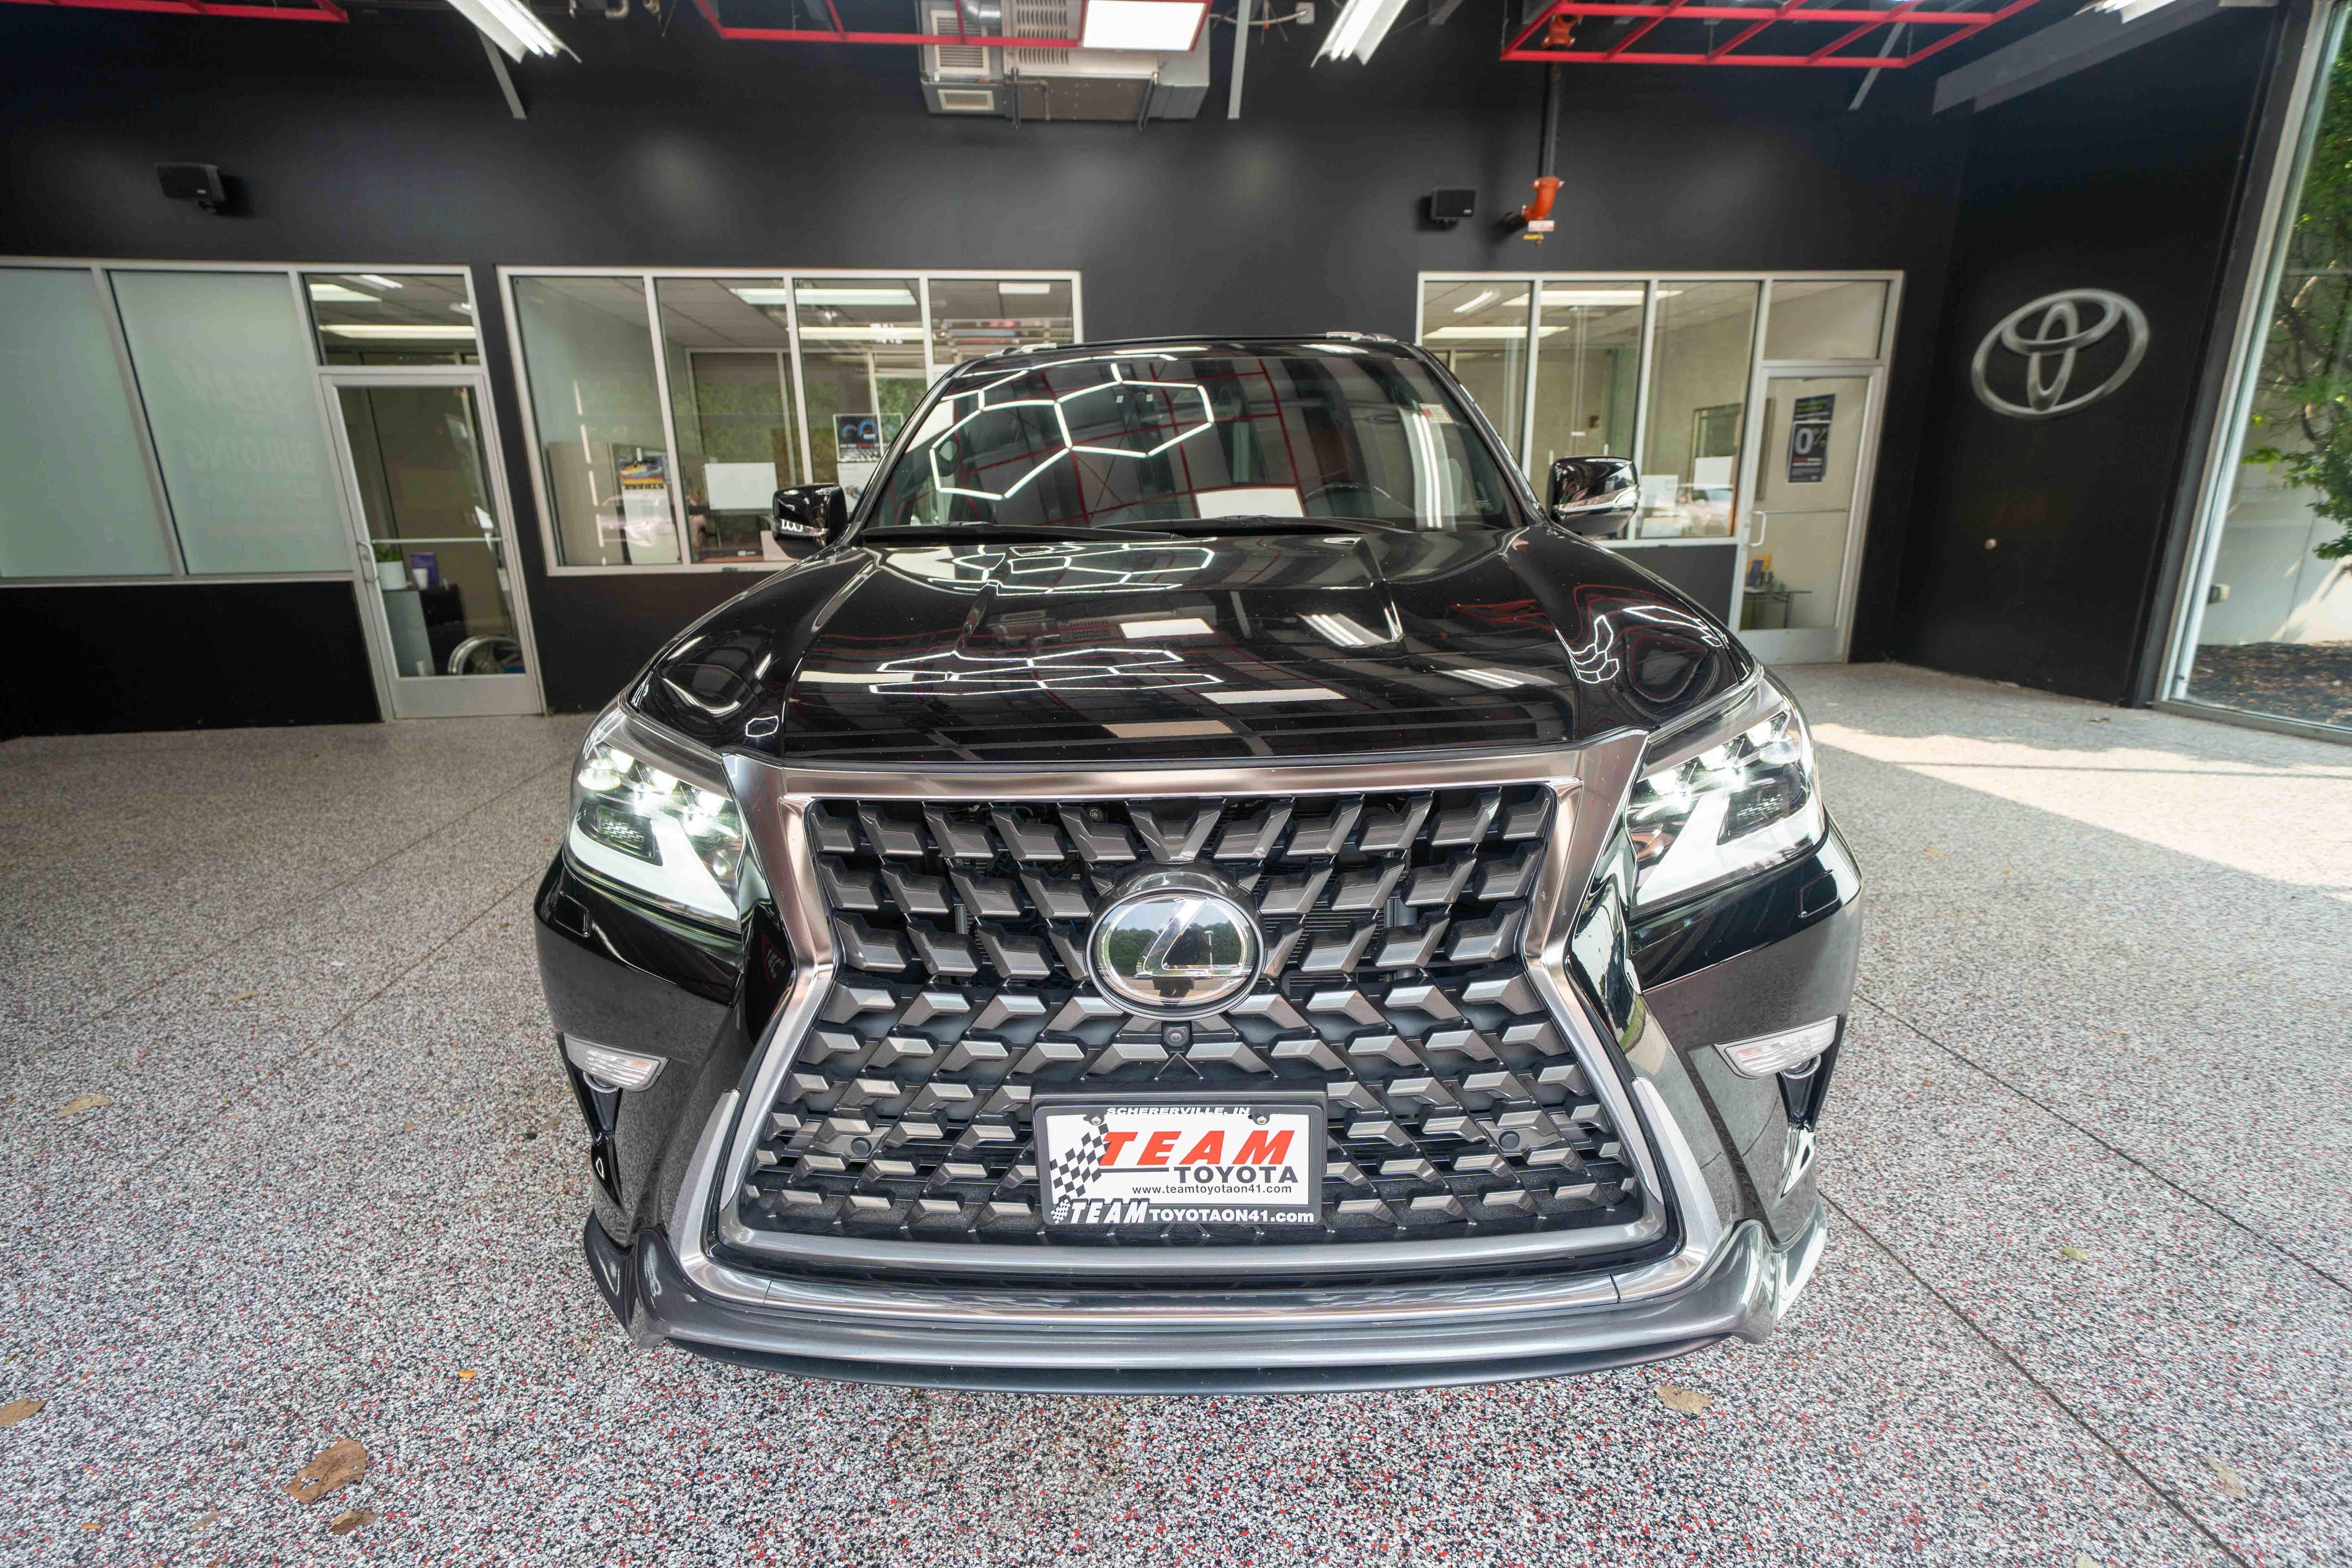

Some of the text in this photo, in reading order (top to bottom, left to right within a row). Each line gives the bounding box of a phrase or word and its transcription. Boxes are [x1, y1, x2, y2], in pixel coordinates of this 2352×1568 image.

[1099, 1130, 1295, 1166] TEAM
[1174, 1166, 1298, 1183] TOYOTA
[1132, 1184, 1292, 1194] www.teamtoyotaon41.com
